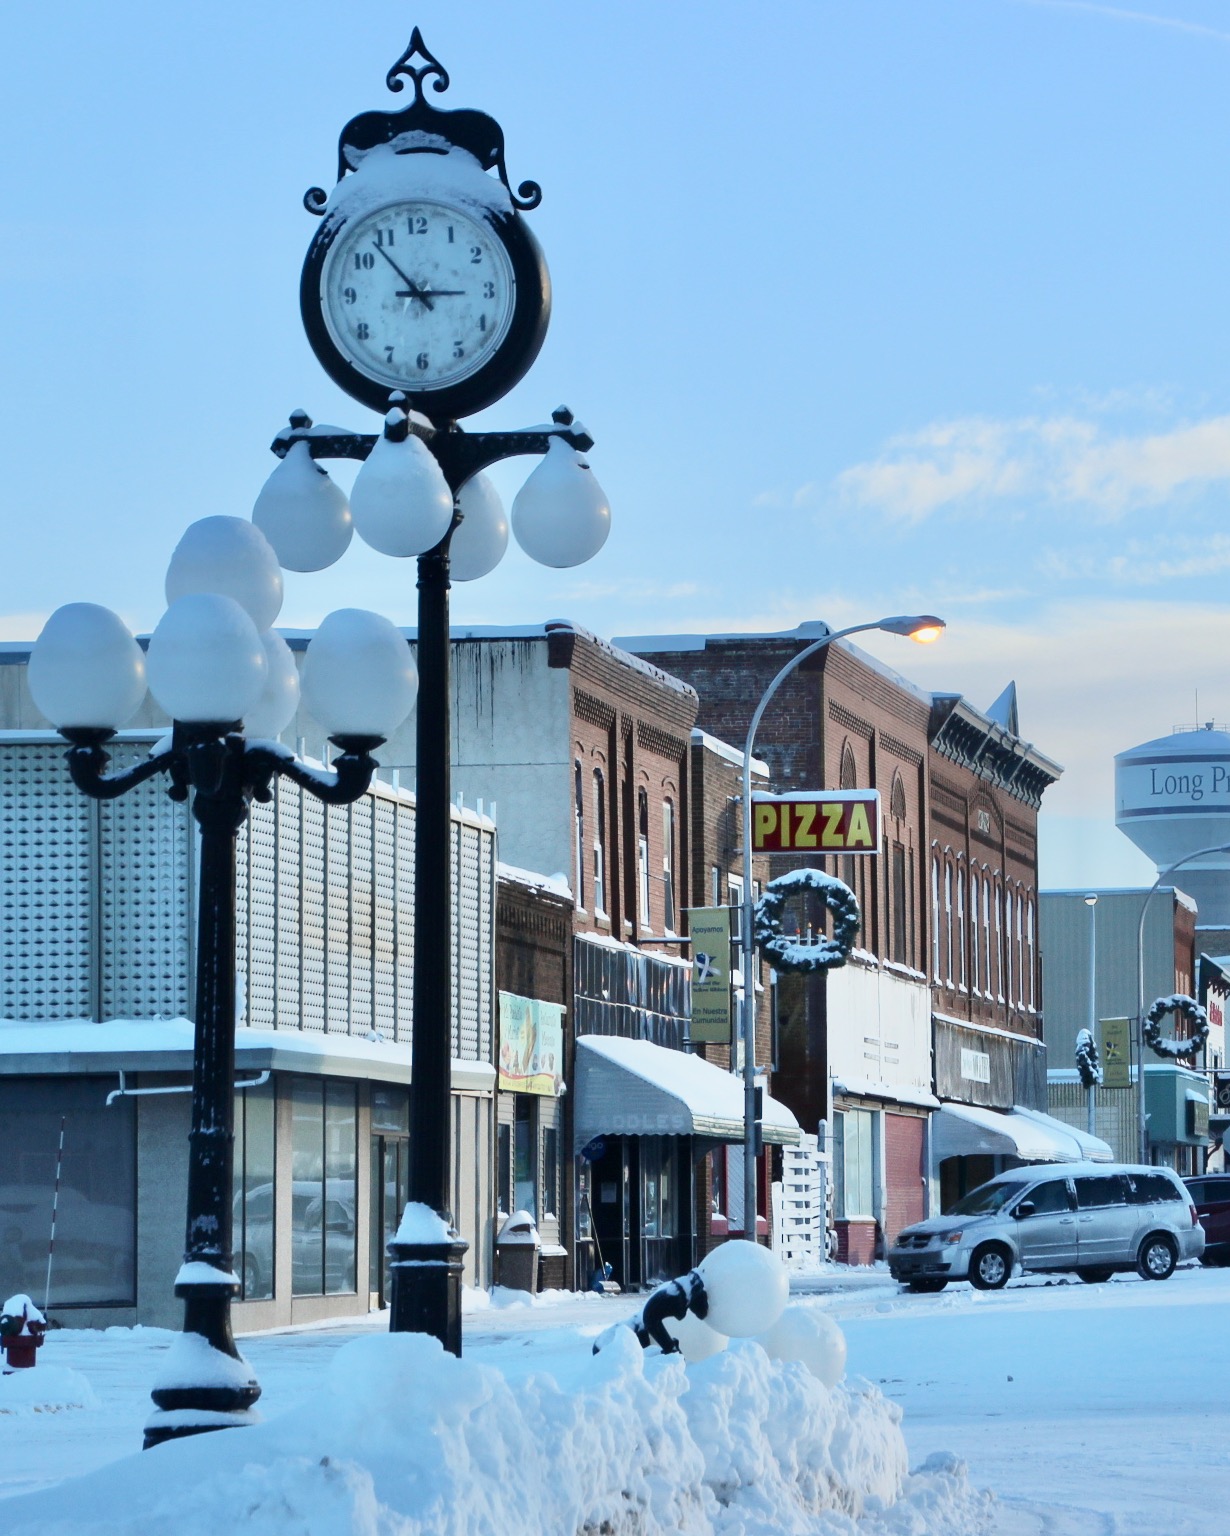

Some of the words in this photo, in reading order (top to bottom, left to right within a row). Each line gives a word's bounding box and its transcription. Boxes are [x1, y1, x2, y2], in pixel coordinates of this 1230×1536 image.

[407, 216, 428, 235] 12
[447, 226, 455, 243] 1
[376, 229, 395, 247] 11
[354, 252, 374, 270] 10
[470, 246, 482, 264] 2
[344, 287, 357, 305] 9
[483, 281, 495, 299] 3
[357, 322, 370, 340] 8
[475, 313, 487, 332] 4
[384, 345, 395, 363] 7
[452, 340, 464, 358] 5
[416, 352, 429, 370] 6
[1150, 768, 1204, 801] Long
[754, 802, 873, 848] PIZZA
[692, 926, 724, 934] Apoyamos
